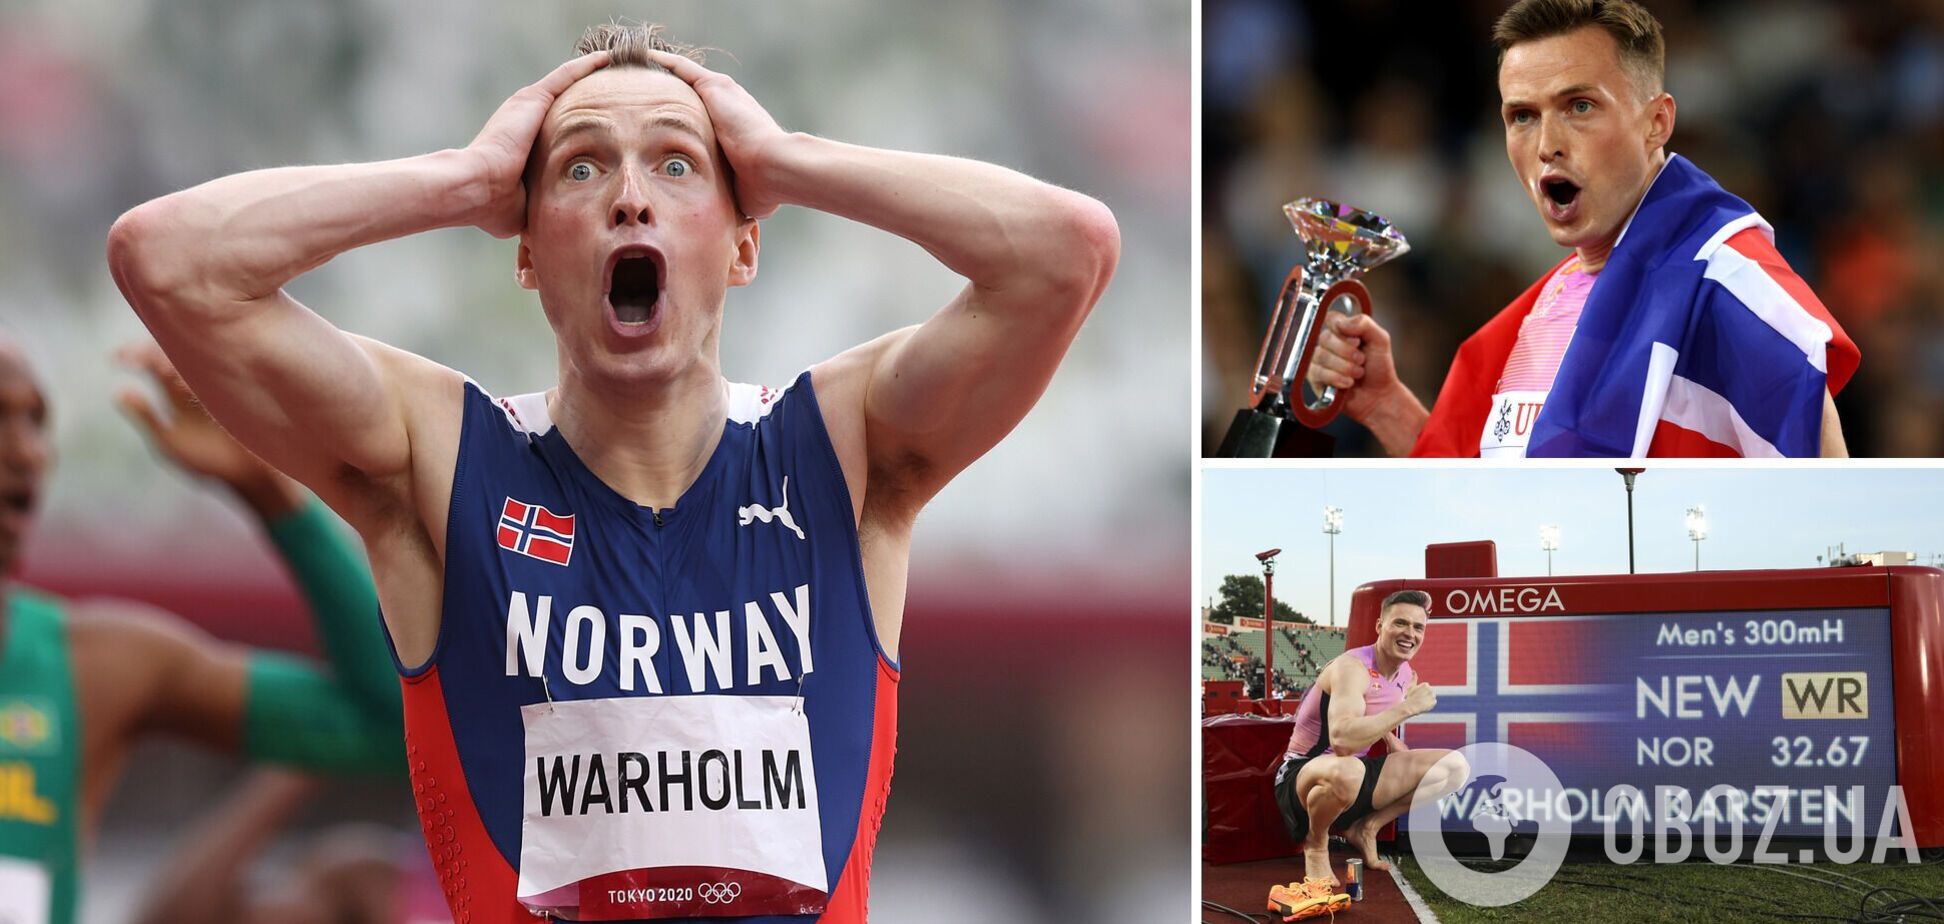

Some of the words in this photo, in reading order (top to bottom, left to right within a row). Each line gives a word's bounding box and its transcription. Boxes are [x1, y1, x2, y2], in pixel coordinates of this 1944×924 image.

[1446, 587, 1565, 614] OMEGA
[506, 584, 815, 694] NORWAY
[1656, 621, 1736, 646] Men's
[1744, 619, 1844, 645] 300mH
[1636, 674, 1761, 719] NEW
[1786, 677, 1863, 714] WR
[1637, 736, 1714, 766] NOR
[1771, 735, 1870, 767] 32.67
[537, 749, 806, 817] WARHOLM
[608, 888, 656, 904] TOKYO
[659, 887, 693, 902] 2020
